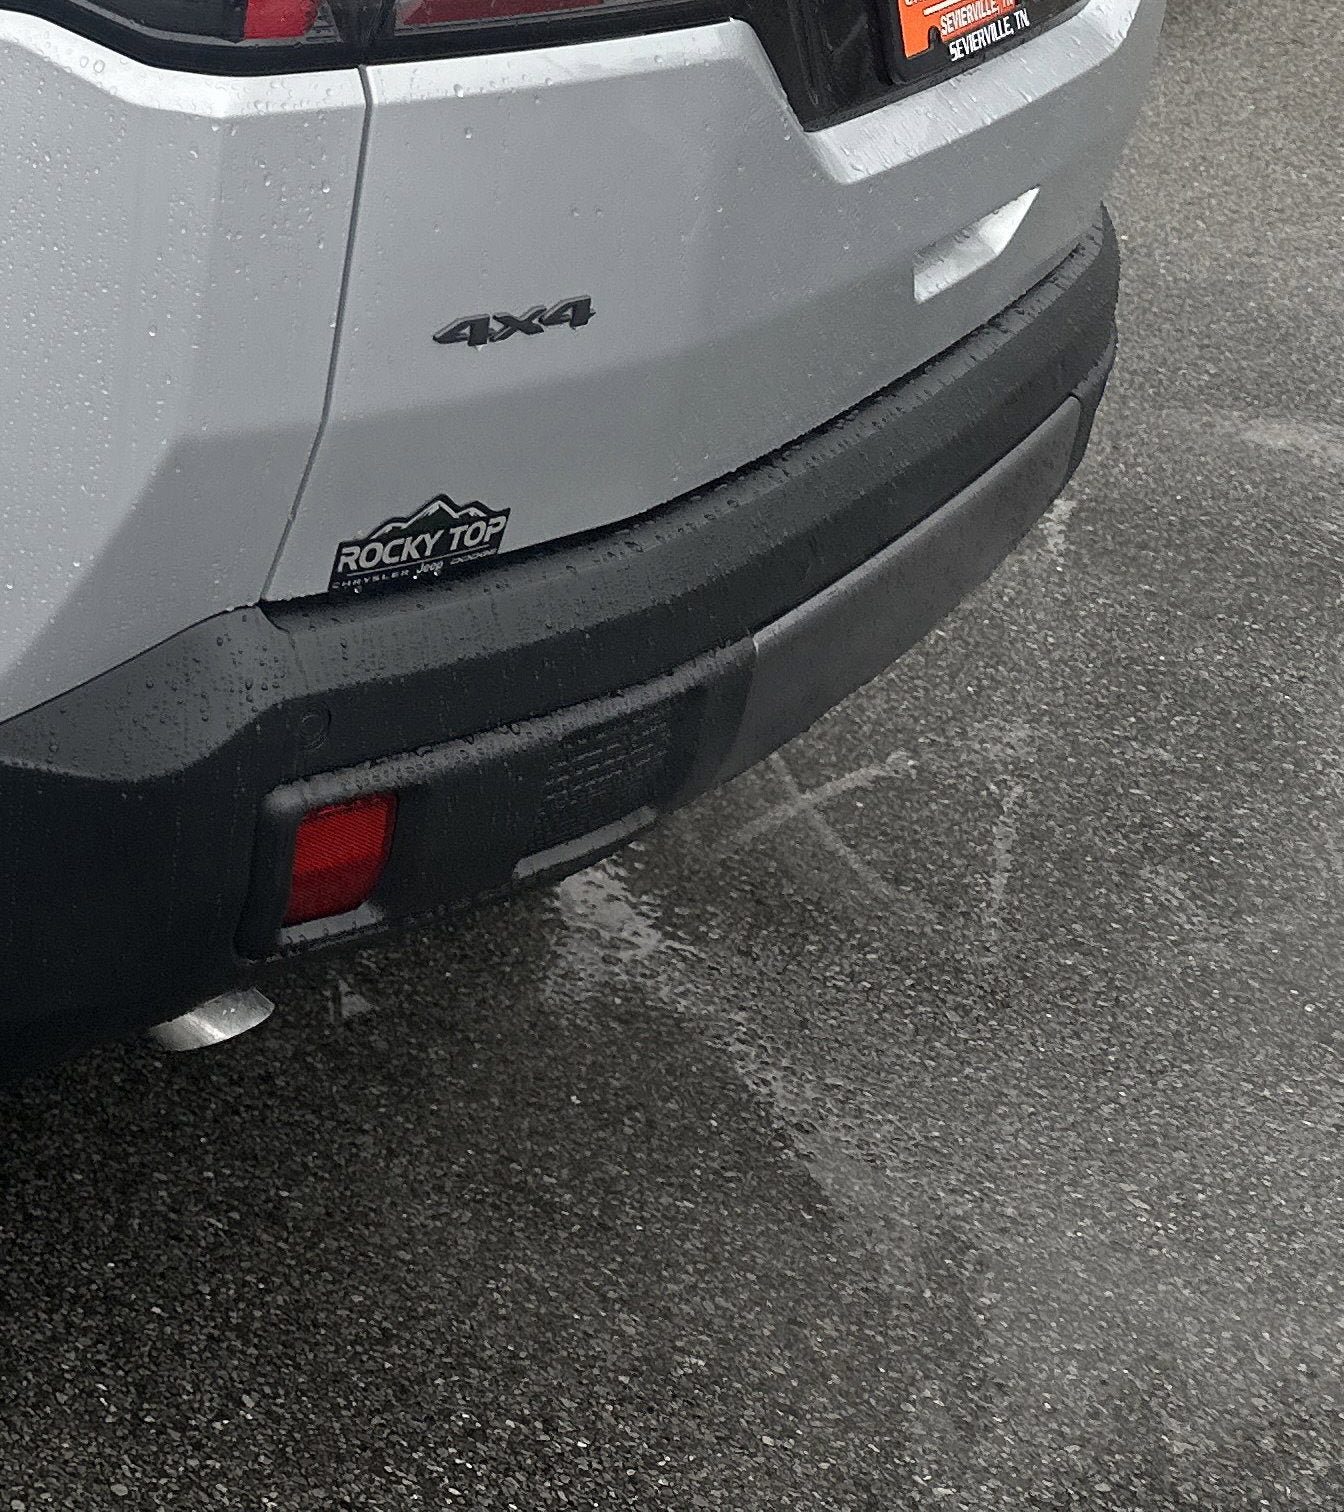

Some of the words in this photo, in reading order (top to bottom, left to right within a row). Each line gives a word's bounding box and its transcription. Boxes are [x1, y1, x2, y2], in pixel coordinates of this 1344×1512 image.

[949, 16, 1014, 62] SEVIERVILLE,
[1014, 8, 1030, 30] TN
[337, 529, 445, 573] ROCKY
[448, 515, 507, 551] TOP
[416, 560, 444, 574] Jeep
